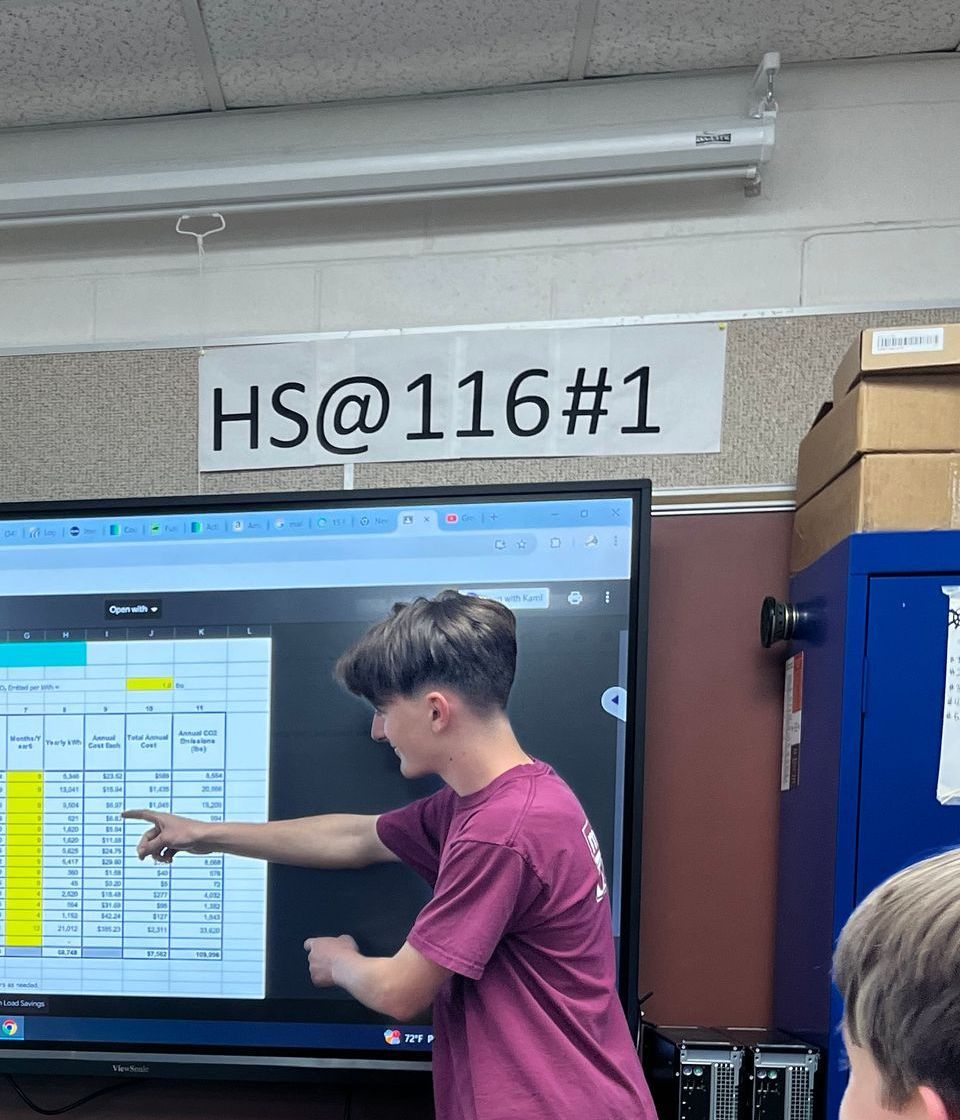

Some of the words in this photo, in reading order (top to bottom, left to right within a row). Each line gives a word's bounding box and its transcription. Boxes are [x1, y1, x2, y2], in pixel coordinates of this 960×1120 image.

[213, 366, 660, 454] HS@116#1
[109, 605, 130, 616] Open
[131, 604, 148, 614] with
[20, 1001, 45, 1009] Savings
[404, 1033, 424, 1042] 72°F
